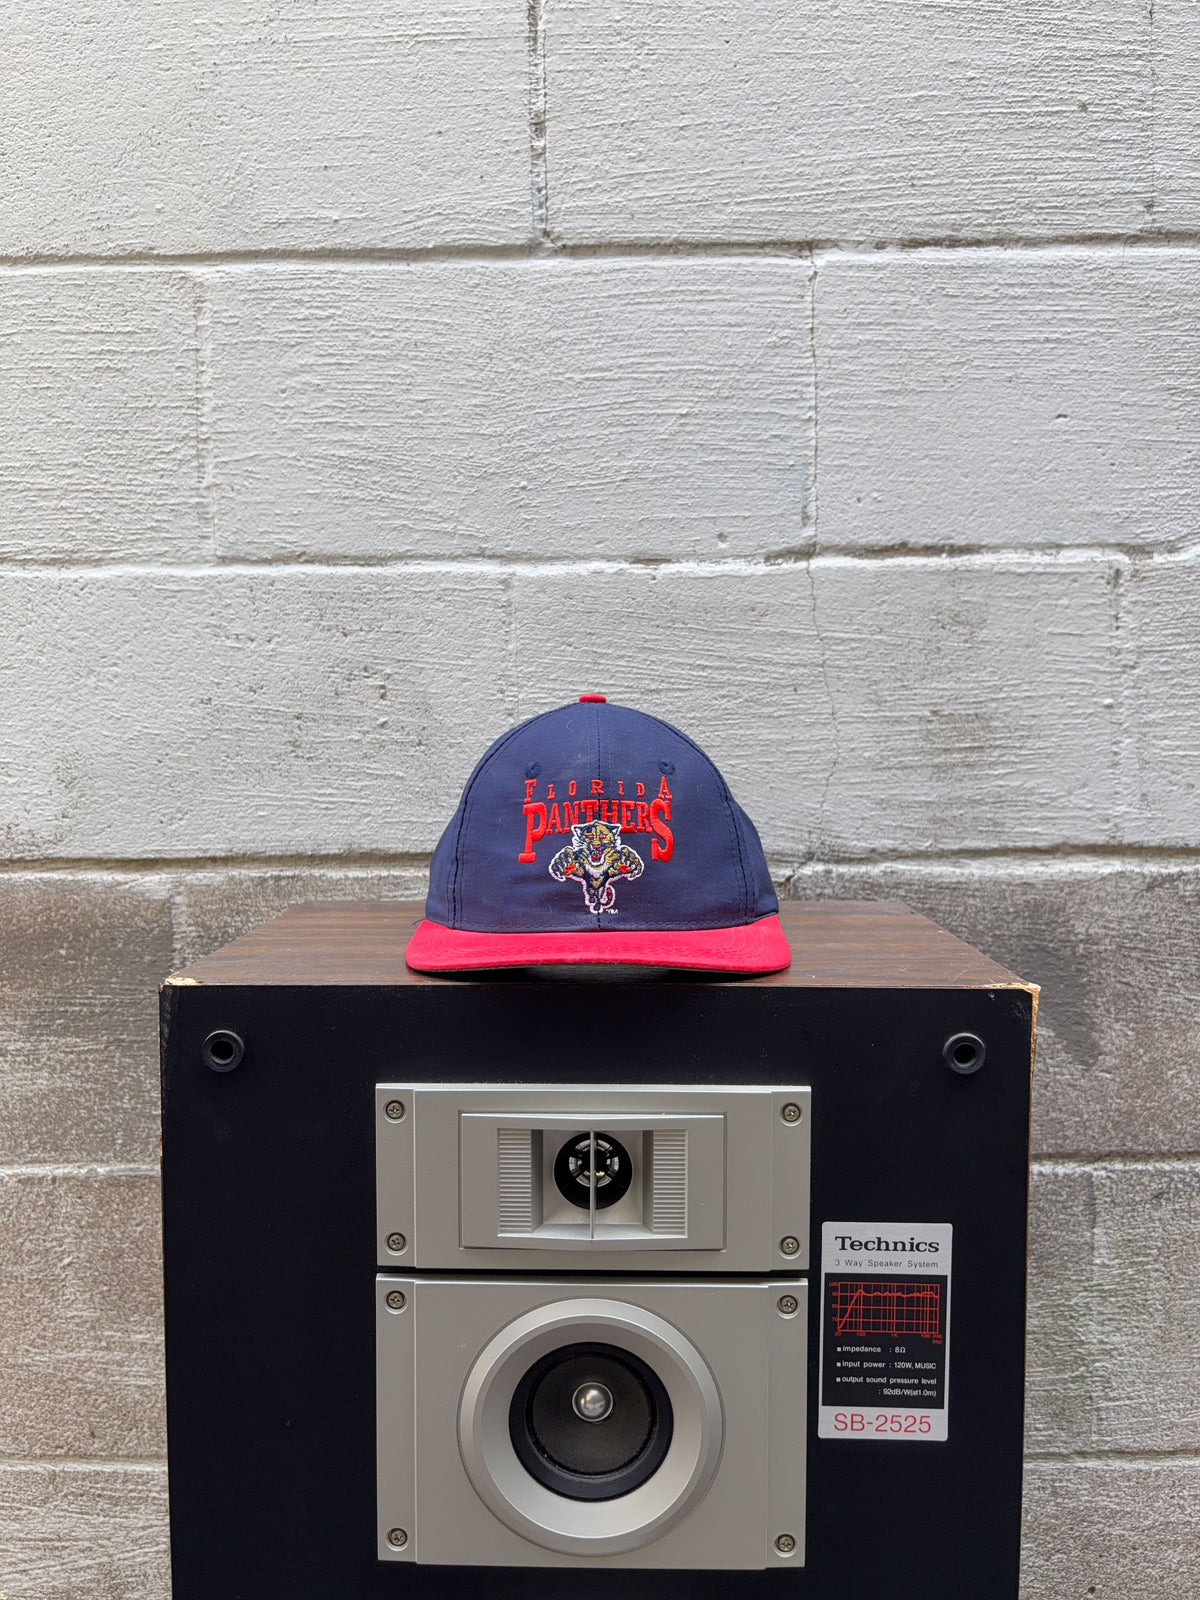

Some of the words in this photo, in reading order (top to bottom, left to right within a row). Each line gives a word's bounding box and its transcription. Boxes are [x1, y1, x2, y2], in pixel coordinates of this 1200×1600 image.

[524, 776, 672, 802] FLORIDA
[518, 798, 674, 863] PANTHERS
[835, 1236, 940, 1253] Technics
[868, 1260, 902, 1268] Speaker
[908, 1260, 939, 1269] System
[843, 1345, 881, 1354] impedance
[842, 1360, 860, 1368] input
[863, 1361, 886, 1369] power
[842, 1375, 863, 1383] output
[834, 1413, 931, 1433] SB-2525
